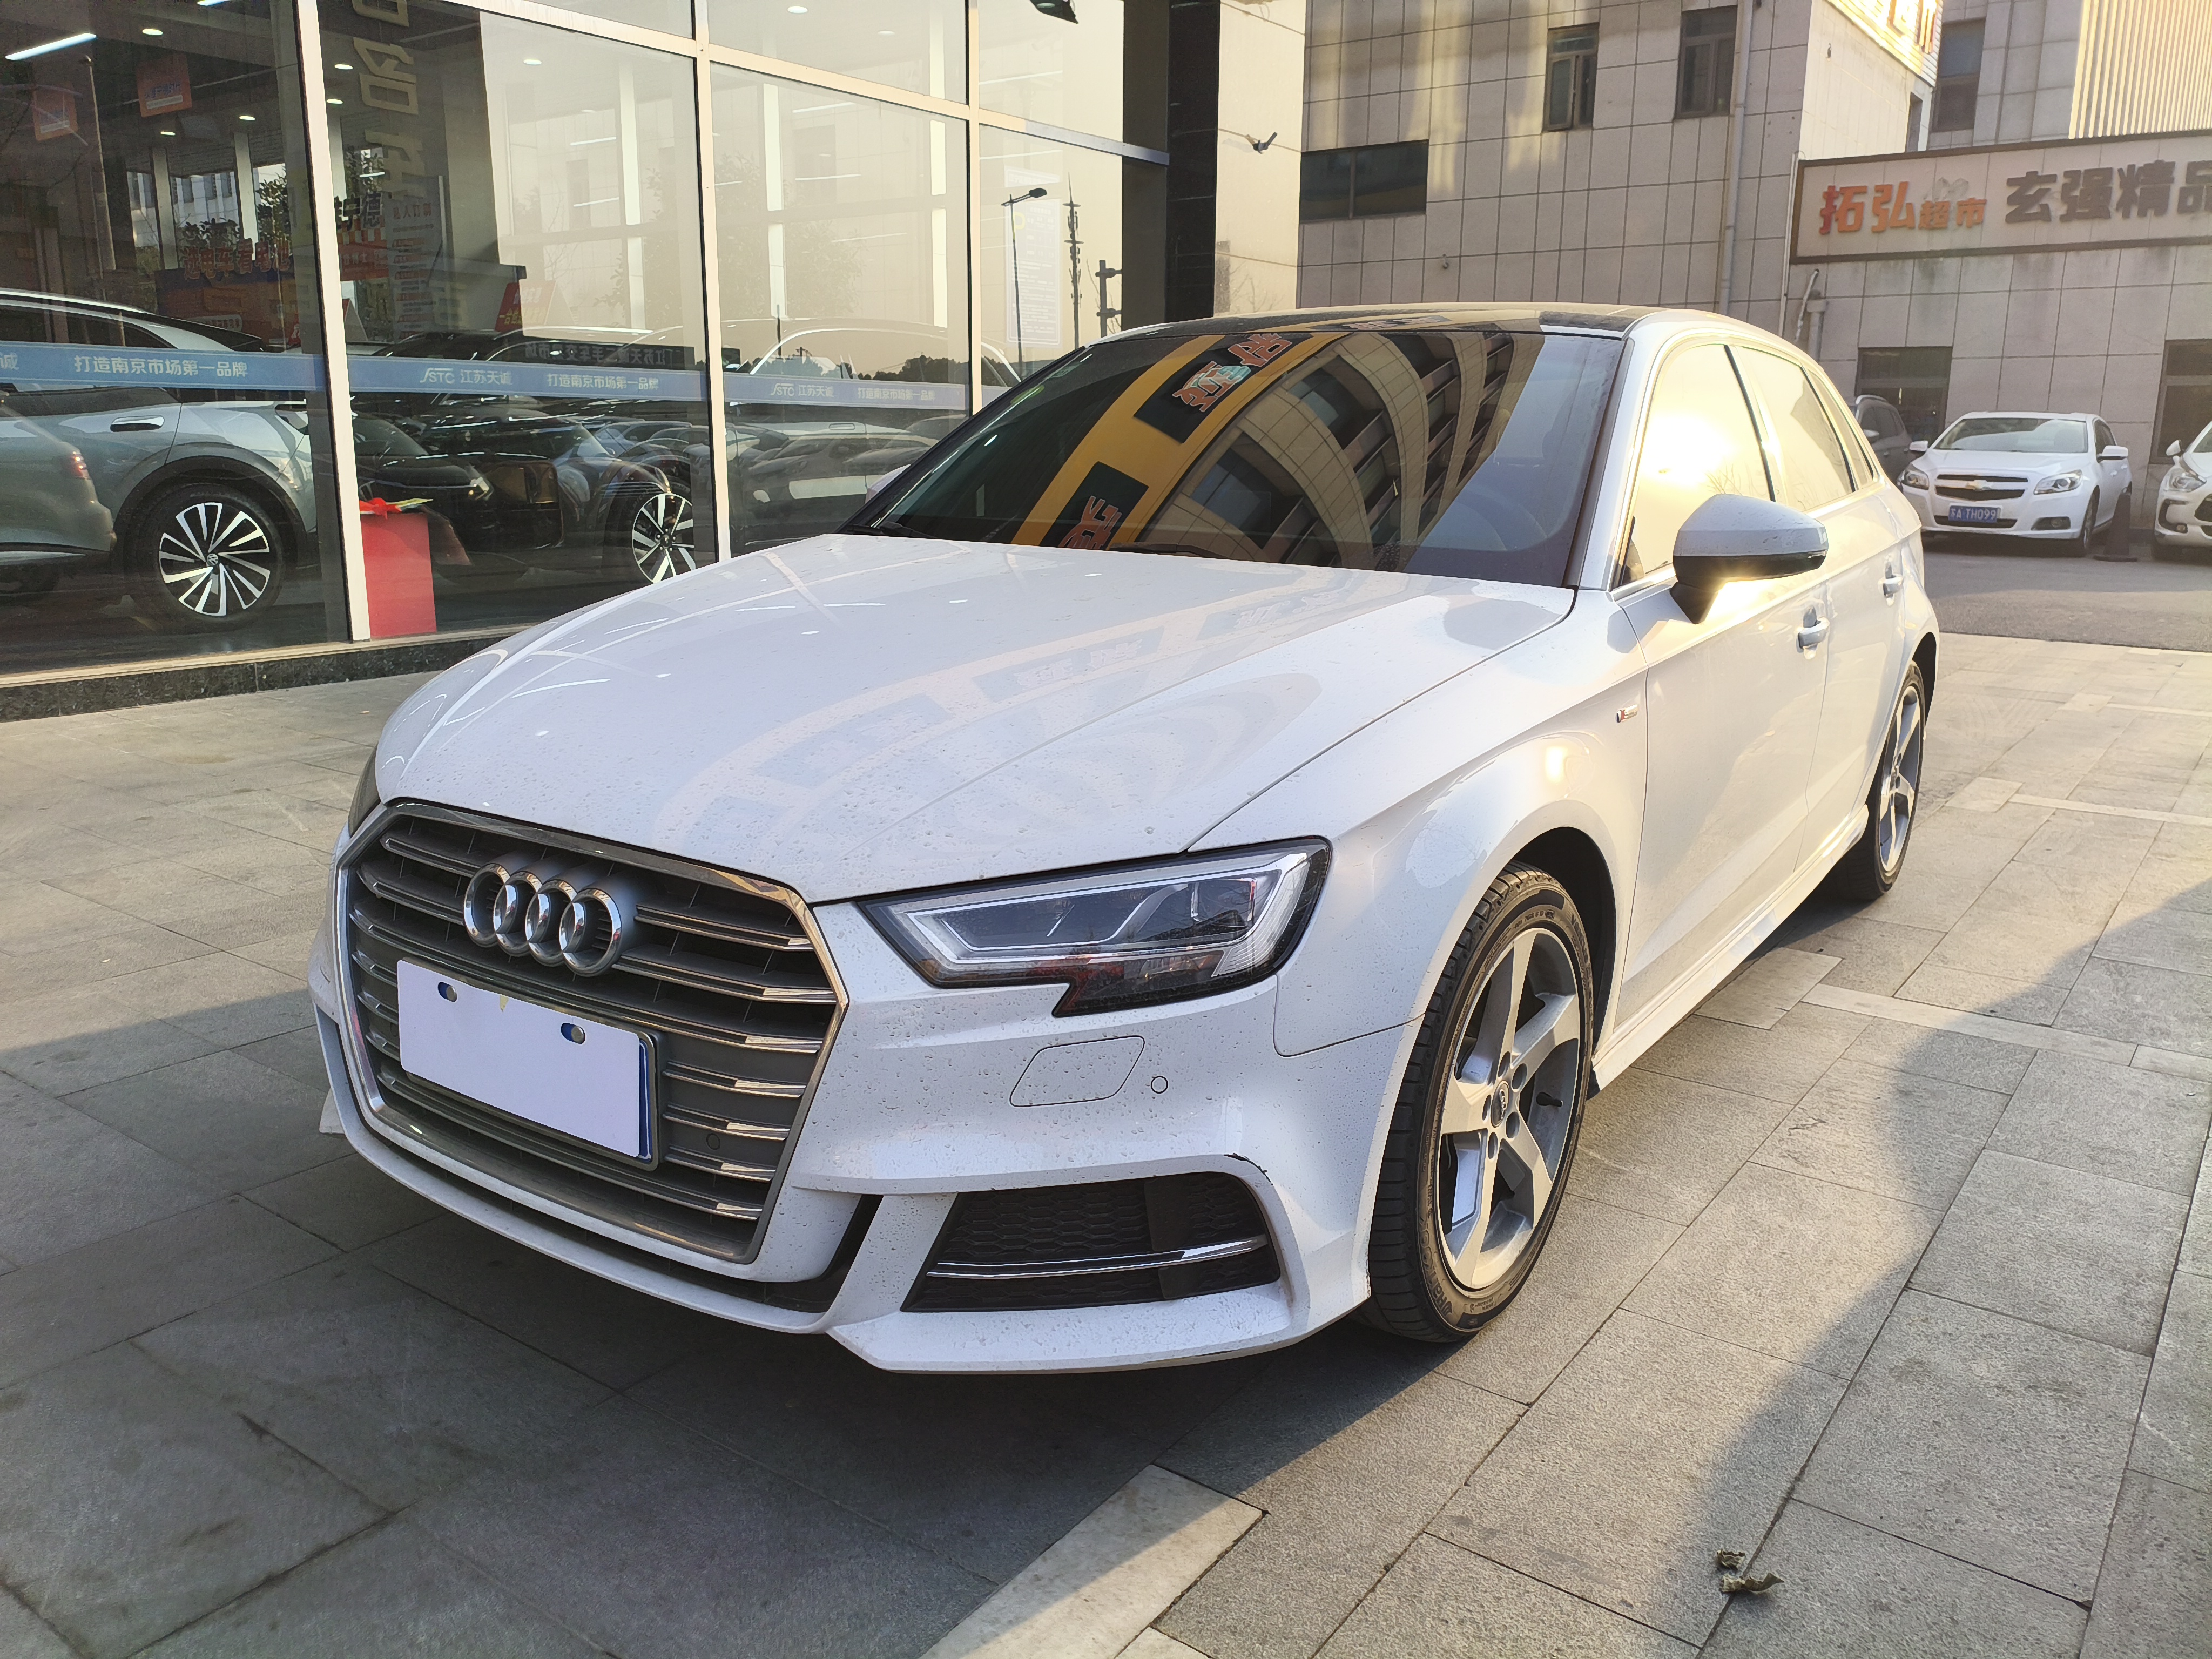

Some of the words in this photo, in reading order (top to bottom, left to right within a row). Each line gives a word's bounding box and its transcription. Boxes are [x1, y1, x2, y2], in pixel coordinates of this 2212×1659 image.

[74, 355, 248, 377] 打造南京市场第一品牌
[547, 374, 660, 391] 打造南京市场第一品牌
[858, 387, 936, 401] 打造南京市场第一品牌
